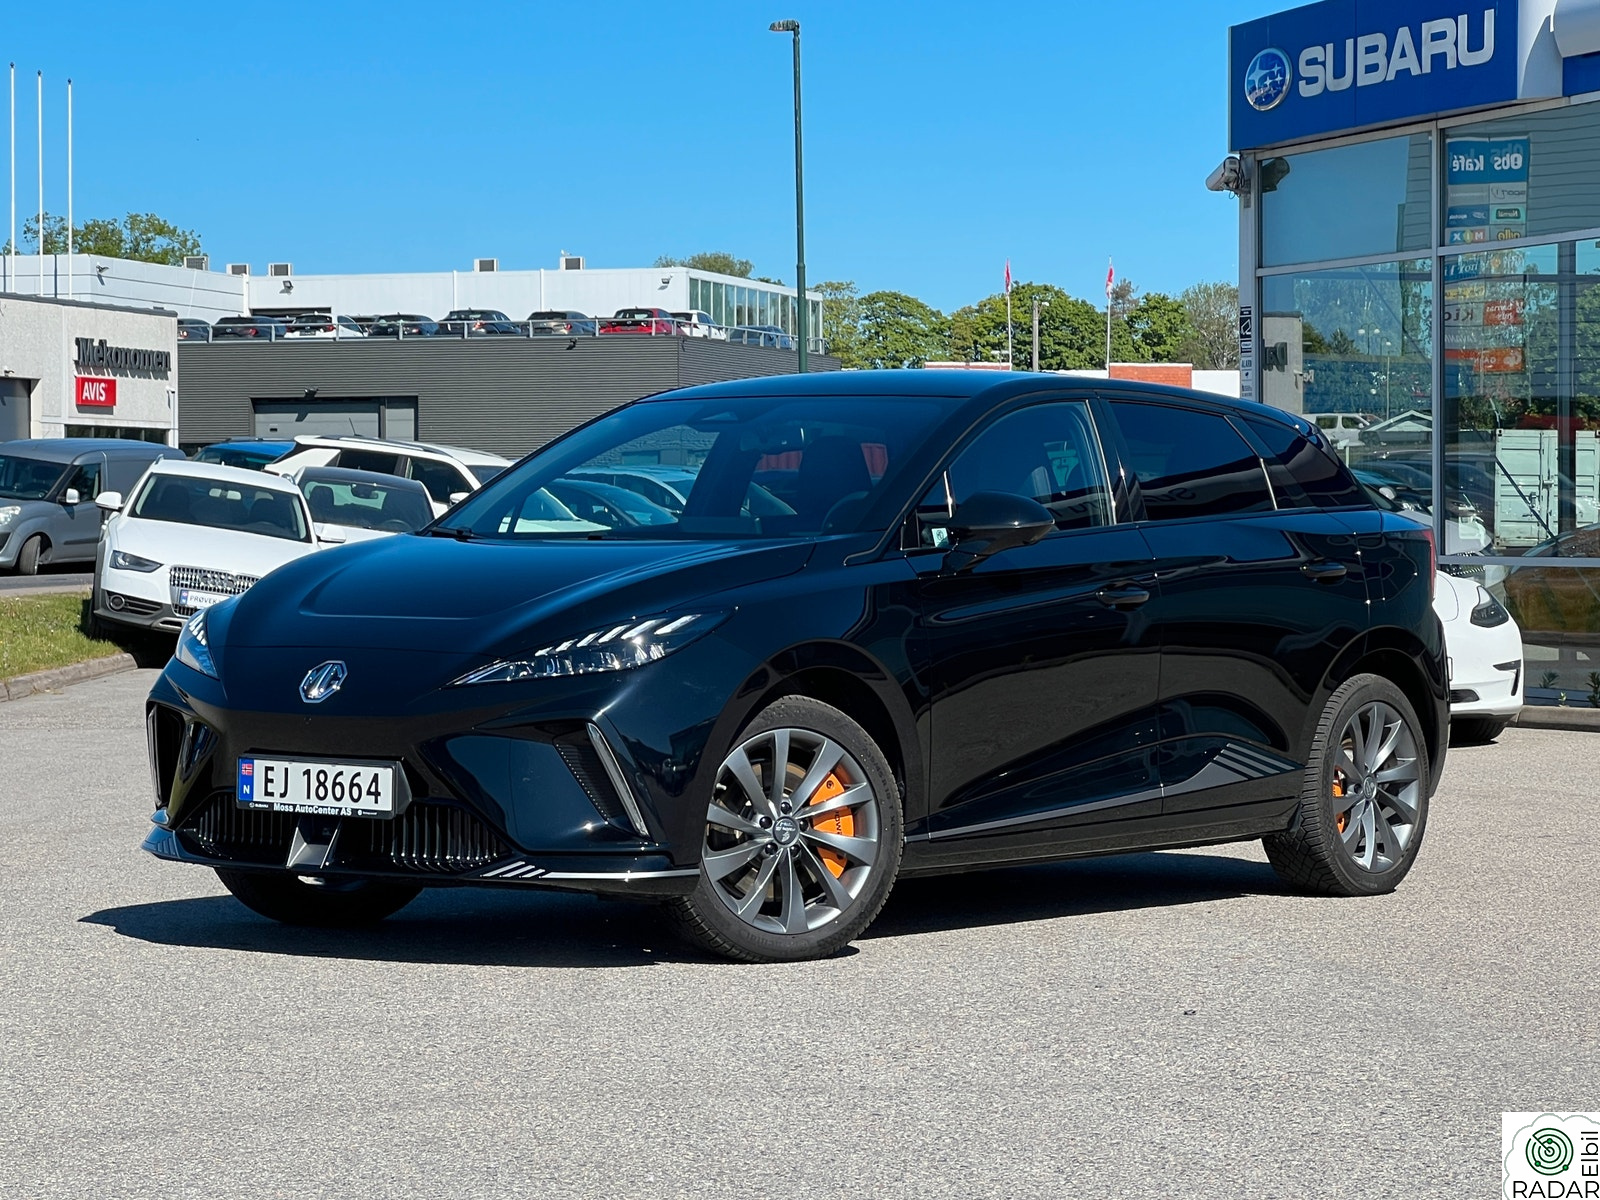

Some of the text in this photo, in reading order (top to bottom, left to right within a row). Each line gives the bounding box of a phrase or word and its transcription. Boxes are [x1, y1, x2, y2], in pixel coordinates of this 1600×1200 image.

[1298, 8, 1495, 98] SUBARU
[75, 337, 171, 371] Mekonomen
[82, 382, 106, 402] AVIS
[243, 785, 250, 794] N
[263, 765, 381, 805] EJ 18664
[273, 802, 294, 813] Moss
[294, 804, 339, 816] AutoCenter
[340, 808, 352, 816] AS
